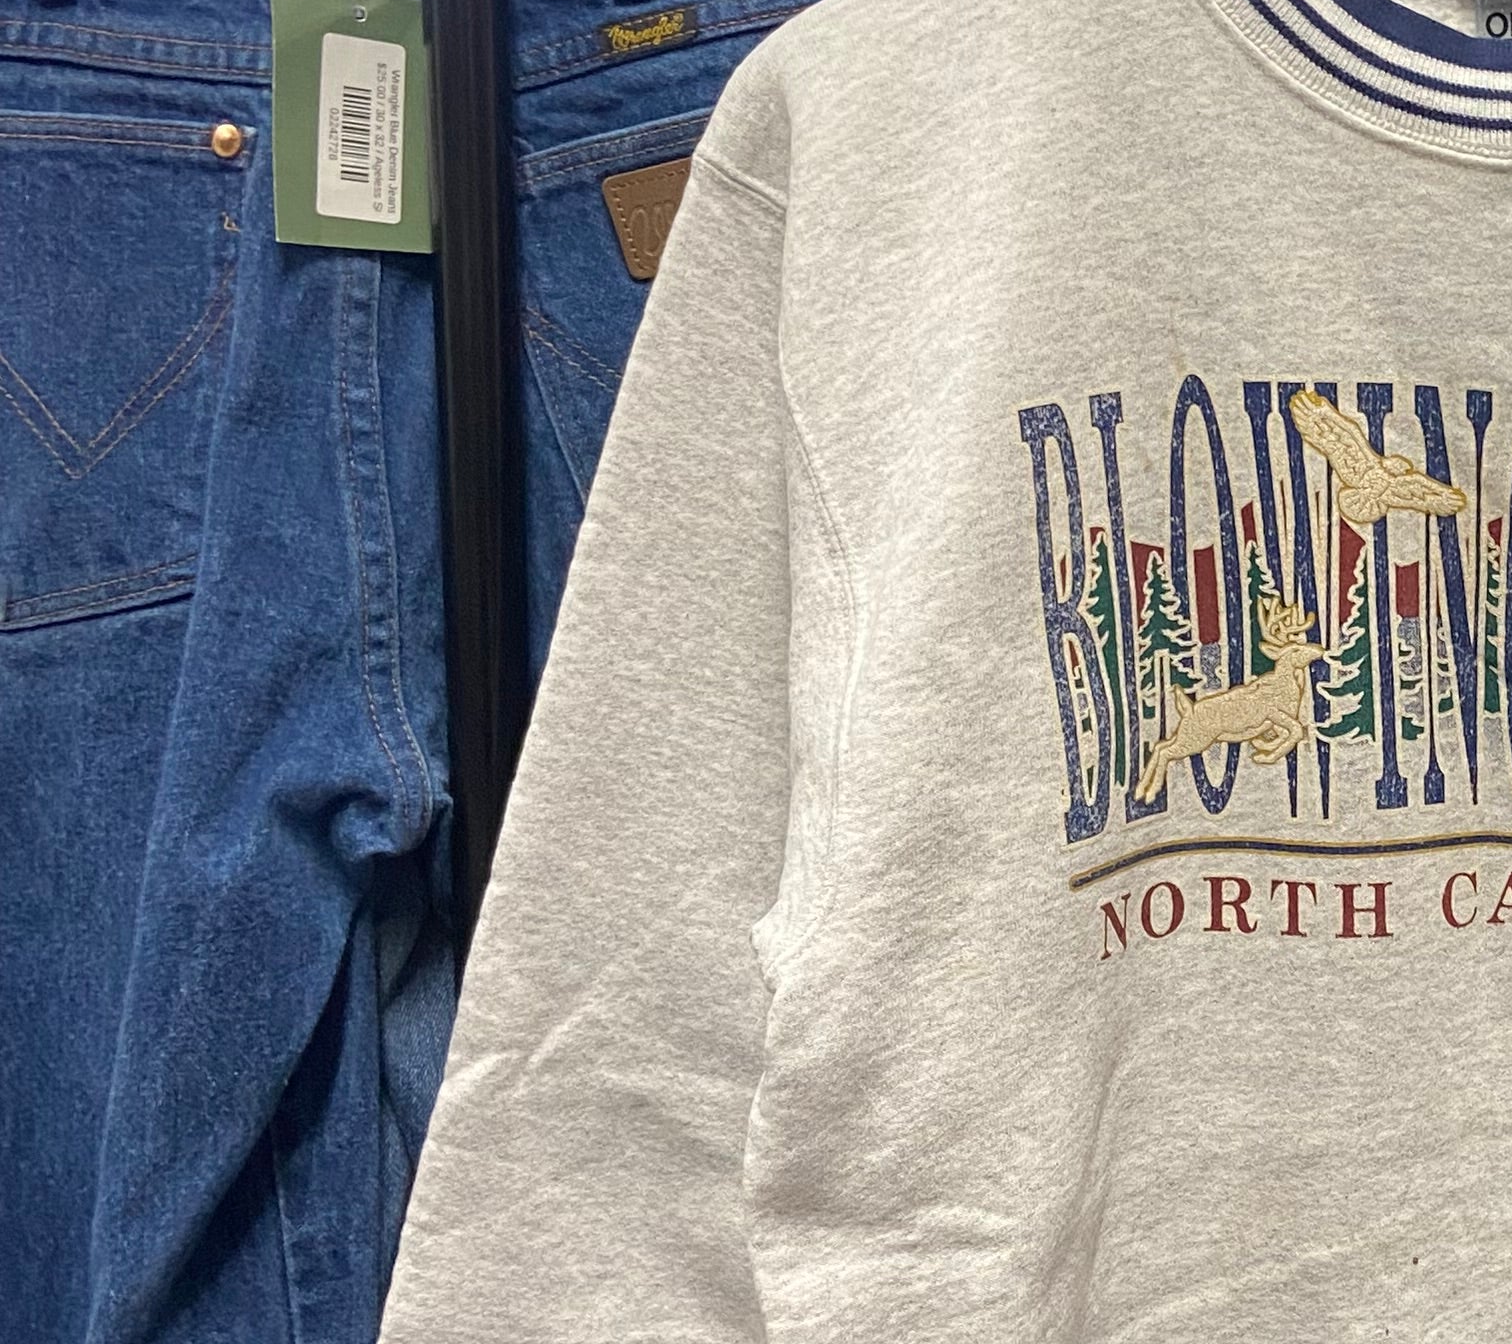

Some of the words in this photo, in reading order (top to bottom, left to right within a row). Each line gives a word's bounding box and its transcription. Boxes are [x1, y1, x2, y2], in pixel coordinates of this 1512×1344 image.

[608, 14, 684, 50] Wrangler
[388, 69, 401, 117] Wrangler
[390, 120, 400, 144] Blue
[372, 156, 384, 199] Ageless
[388, 146, 399, 182] Denim
[387, 183, 398, 214] Jeans
[1100, 872, 1395, 961] NORTH
